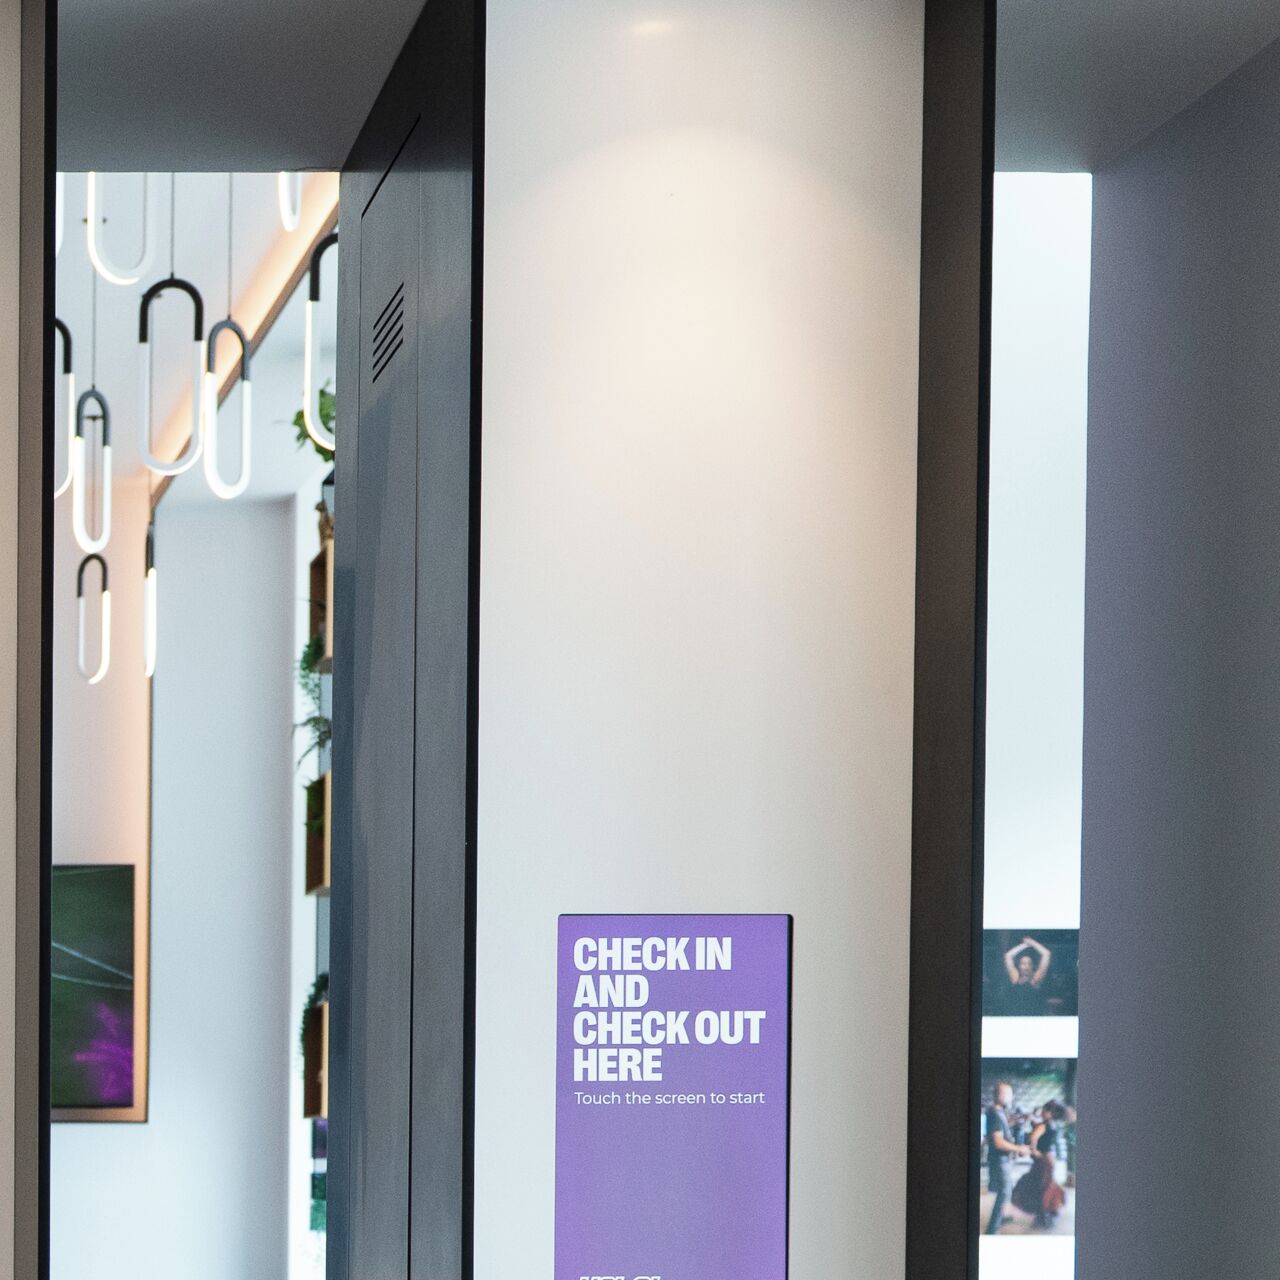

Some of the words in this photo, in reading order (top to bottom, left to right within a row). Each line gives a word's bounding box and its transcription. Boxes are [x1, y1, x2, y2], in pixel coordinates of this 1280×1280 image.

[572, 936, 690, 972] CHECK
[695, 936, 732, 971] IN
[572, 974, 650, 1008] AND
[572, 1010, 690, 1046] CHECK
[694, 1009, 766, 1045] OUT
[573, 1047, 663, 1082] HERE
[574, 1091, 621, 1105] Touch
[625, 1091, 651, 1105] the
[655, 1094, 706, 1105] screen
[710, 1092, 726, 1104] to
[729, 1091, 766, 1104] start
